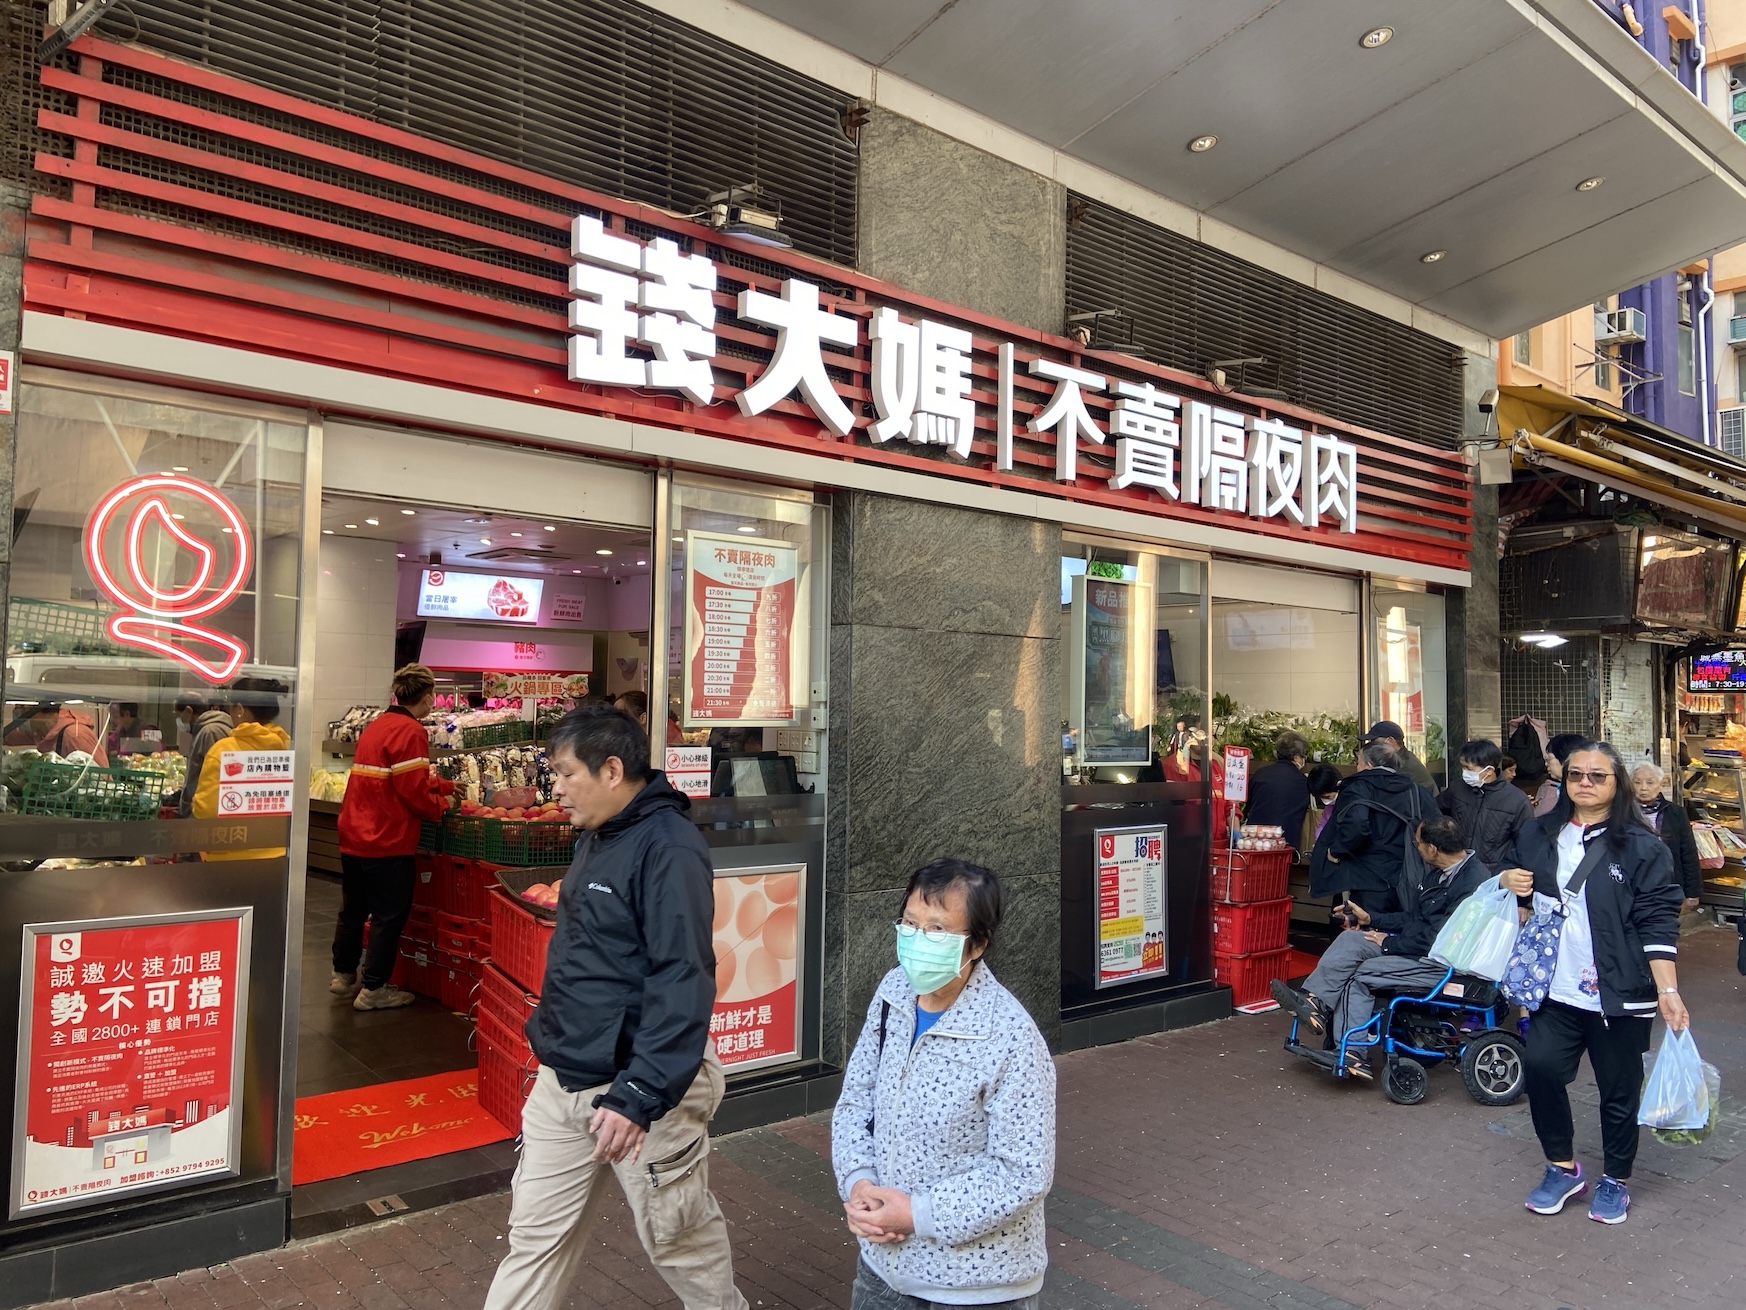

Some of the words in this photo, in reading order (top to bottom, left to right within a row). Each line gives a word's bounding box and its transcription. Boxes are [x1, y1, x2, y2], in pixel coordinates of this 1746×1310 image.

[568, 214, 975, 459] 錢大媽
[1026, 358, 1357, 534] 不賣隔夜肉
[714, 547, 775, 568] 不賣隔夜肉
[510, 681, 564, 696] 火鍋專區
[246, 764, 290, 772] 店內購物籃
[681, 780, 709, 789] 小心地滑
[1134, 836, 1162, 862] 招聘
[50, 950, 222, 988] 誠邀火速加盟
[50, 975, 223, 1027] 勢不可擋
[50, 1028, 88, 1047] 全國
[91, 1023, 140, 1041] 2800+
[145, 1011, 220, 1035] 連鎖門店
[709, 1004, 772, 1034] 新鮮才是
[716, 1028, 765, 1056] 硬道理
[722, 1054, 745, 1065] ERNIGHT
[745, 1051, 758, 1060] JUST
[759, 1048, 776, 1057] FRESH
[159, 1167, 180, 1176] +852
[182, 1162, 203, 1172] 9794
[205, 1157, 226, 1167] 9295
